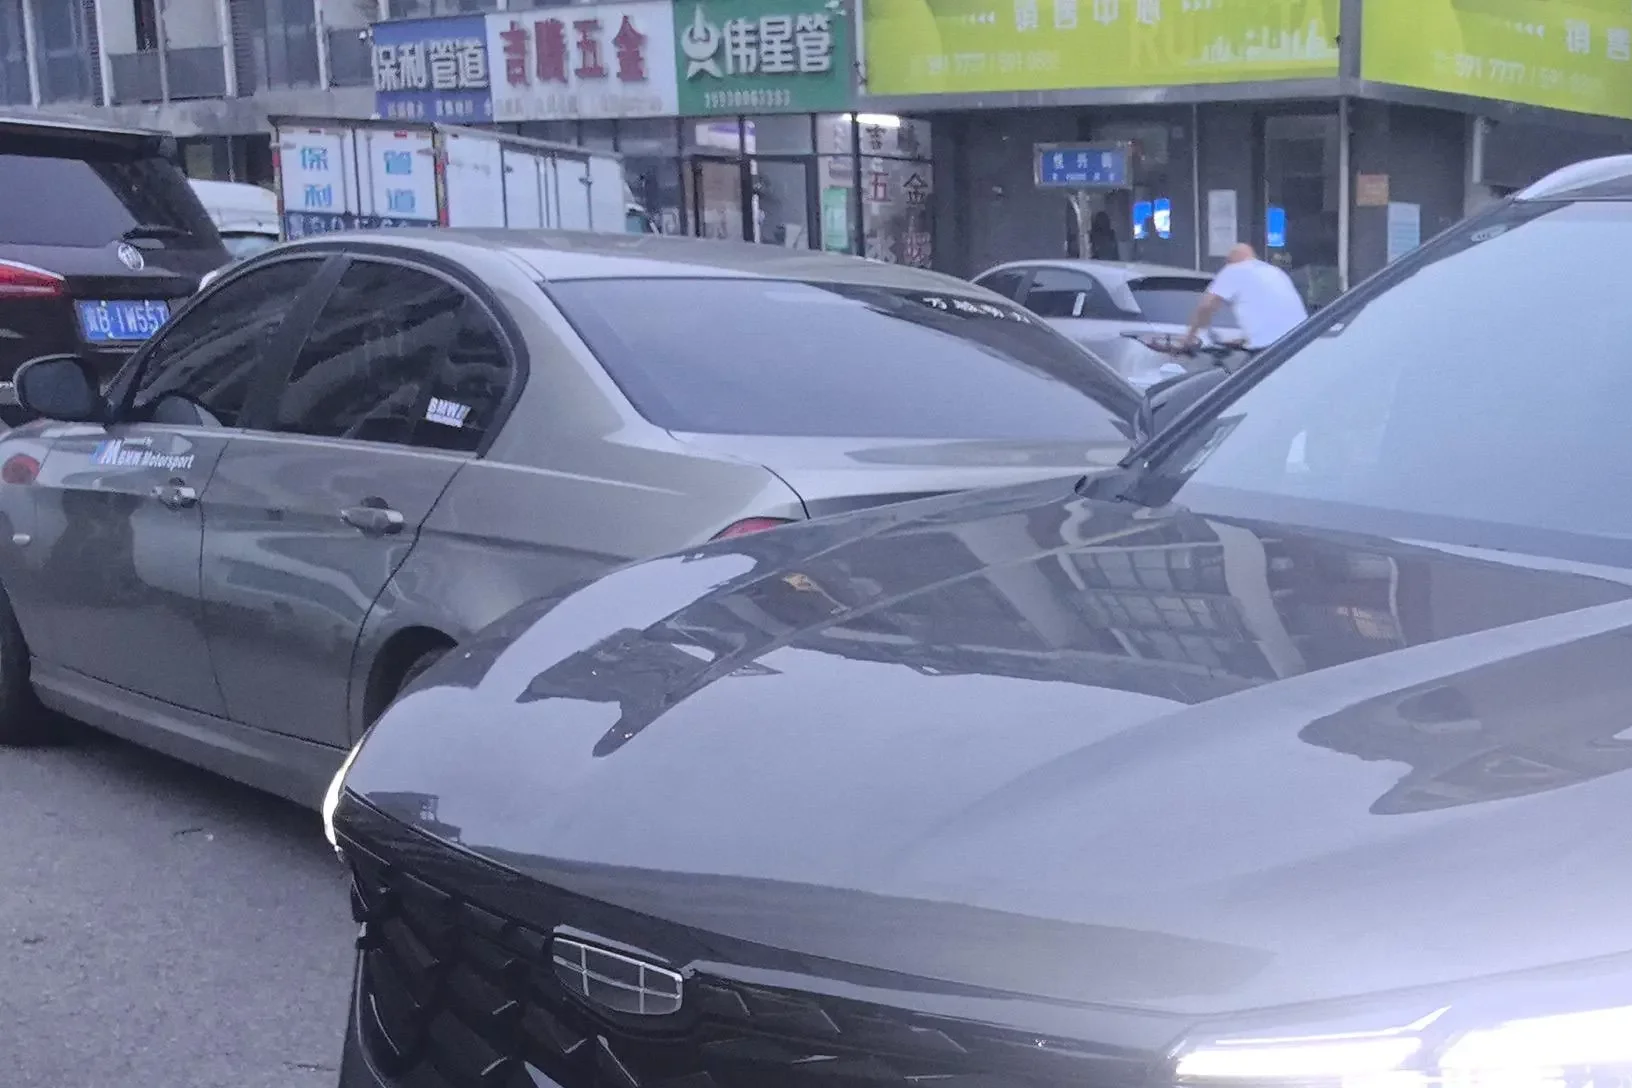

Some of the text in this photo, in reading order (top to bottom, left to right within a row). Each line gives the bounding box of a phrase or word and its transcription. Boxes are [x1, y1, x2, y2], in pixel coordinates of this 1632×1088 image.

[374, 37, 488, 91] 保利管道
[723, 14, 833, 74] 伟星管
[143, 452, 194, 470] Motorsport
